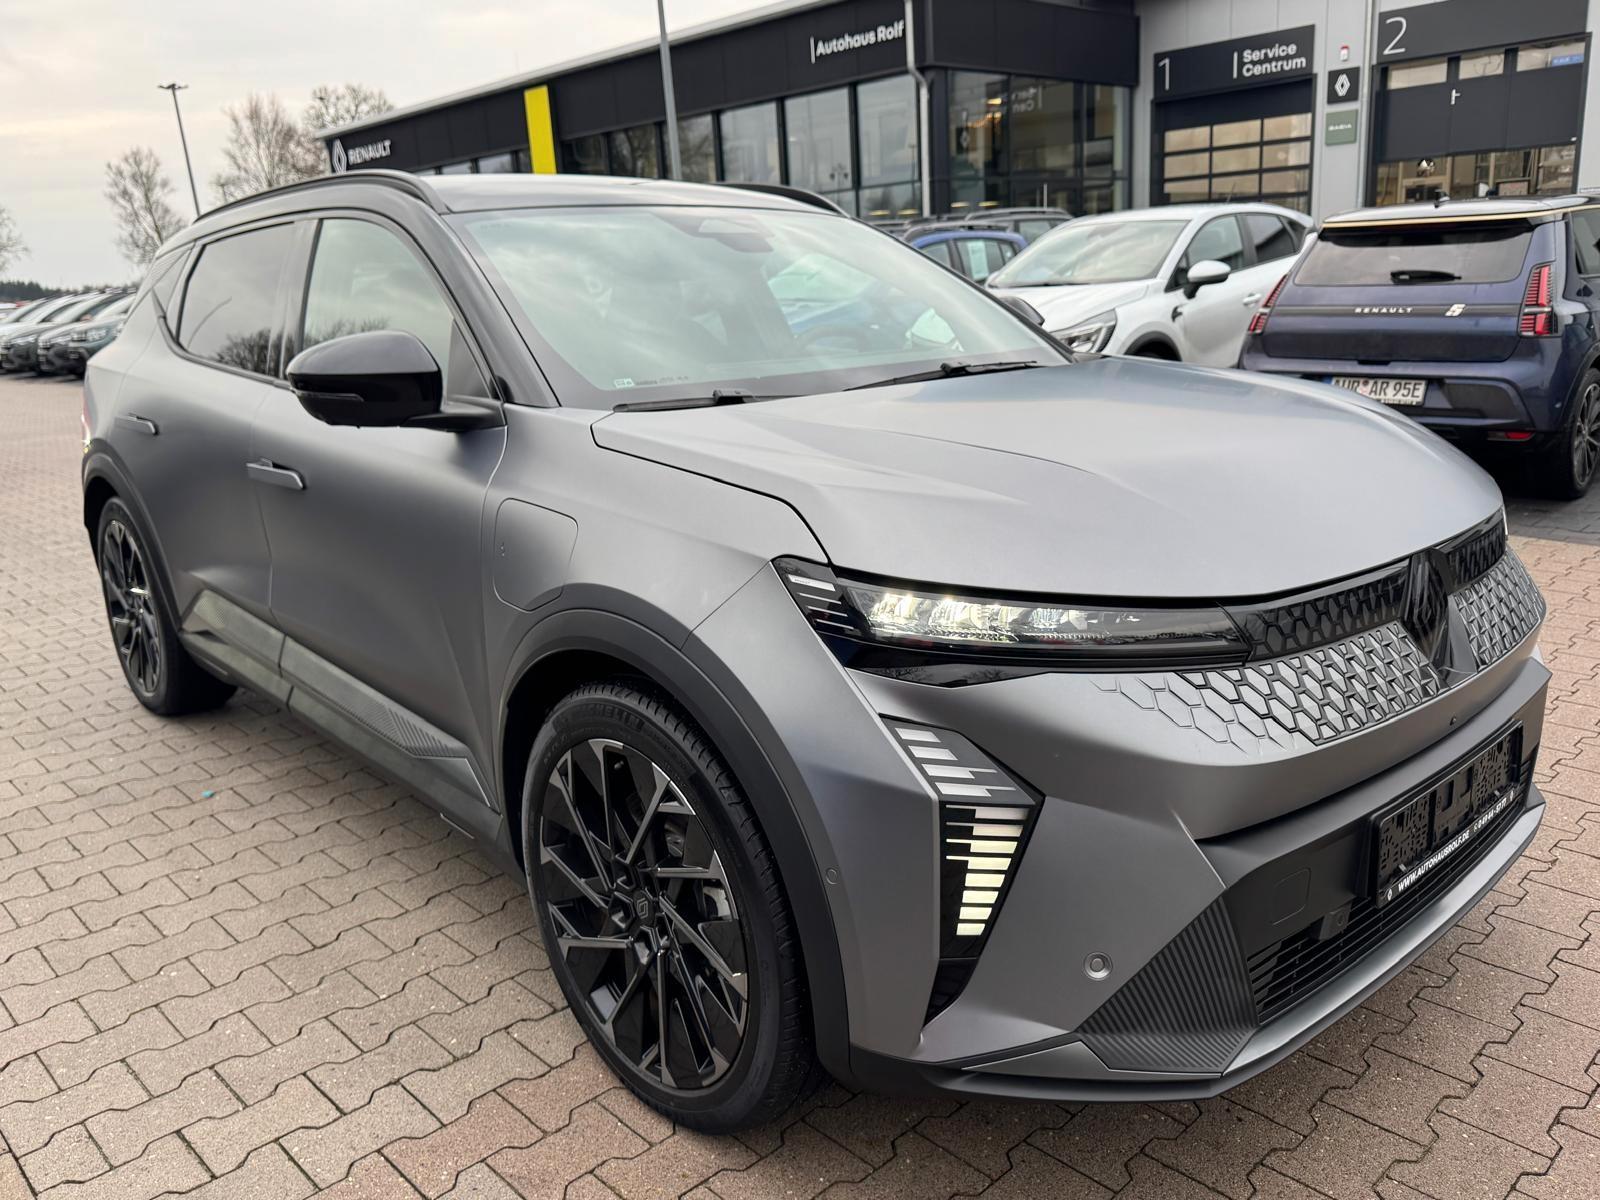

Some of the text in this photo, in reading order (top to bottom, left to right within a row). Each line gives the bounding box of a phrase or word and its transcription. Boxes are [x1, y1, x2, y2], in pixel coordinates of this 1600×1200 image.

[816, 19, 905, 57] Autohaus Rolf
[1383, 16, 1407, 56] 2
[1242, 43, 1297, 63] Service
[1242, 57, 1306, 77] Centrum
[1158, 57, 1170, 91] 1
[348, 139, 391, 166] RENAULT
[1369, 380, 1389, 397] AR
[1393, 382, 1422, 399] 95E
[1398, 829, 1470, 893] WWW.AUTOHAUSROLF.DE
